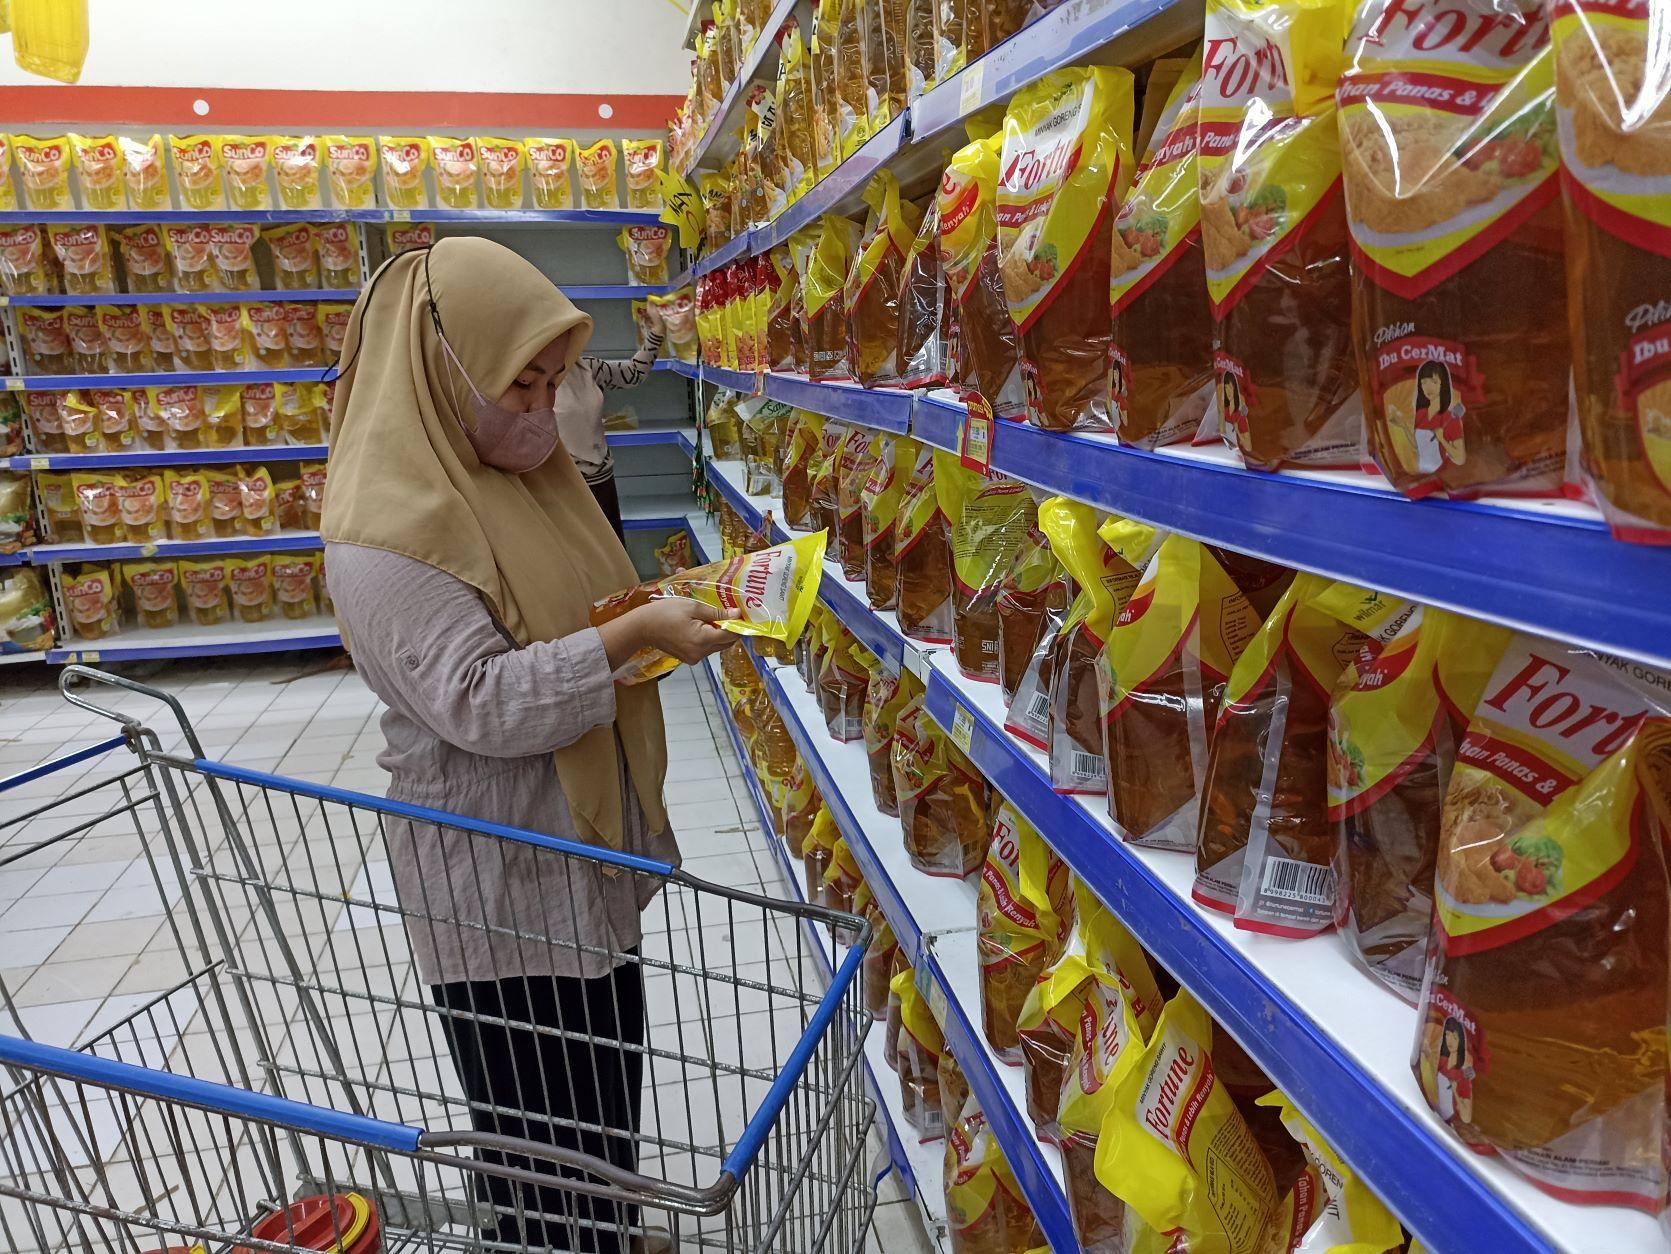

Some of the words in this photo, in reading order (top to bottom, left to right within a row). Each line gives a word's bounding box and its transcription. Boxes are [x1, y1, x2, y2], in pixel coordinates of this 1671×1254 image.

[1383, 79, 1453, 101] Panas
[1456, 89, 1478, 106] &
[223, 145, 265, 160] SunCo
[329, 146, 368, 161] SunCo
[434, 147, 472, 162] SunCo
[480, 146, 517, 162] SunCo
[529, 146, 564, 162] SunCo
[55, 231, 98, 246] SunCo
[170, 228, 210, 243] SunCo
[210, 228, 251, 243] SunCo
[393, 229, 430, 244] SunCo
[631, 226, 666, 240] SunCo
[1379, 352, 1398, 371] Ibu
[1400, 344, 1463, 367] CerMat
[1634, 336, 1669, 365] Ibu
[114, 482, 155, 497] SunCo
[186, 569, 223, 583] SunCo
[234, 564, 266, 579] SunCo
[274, 563, 312, 577] SunCo
[133, 571, 173, 586] SunCo
[745, 550, 782, 609] Fortune
[1353, 600, 1387, 622] wilmar
[981, 641, 994, 651] SNI
[1487, 751, 1539, 783] Panas
[1535, 779, 1558, 794] &
[1003, 901, 1036, 928] Renyah
[1436, 994, 1477, 1036] CerMat
[1145, 1046, 1195, 1140] Fortune
[1196, 1072, 1214, 1103] Renyah
[1297, 1175, 1310, 1204] Tahan
